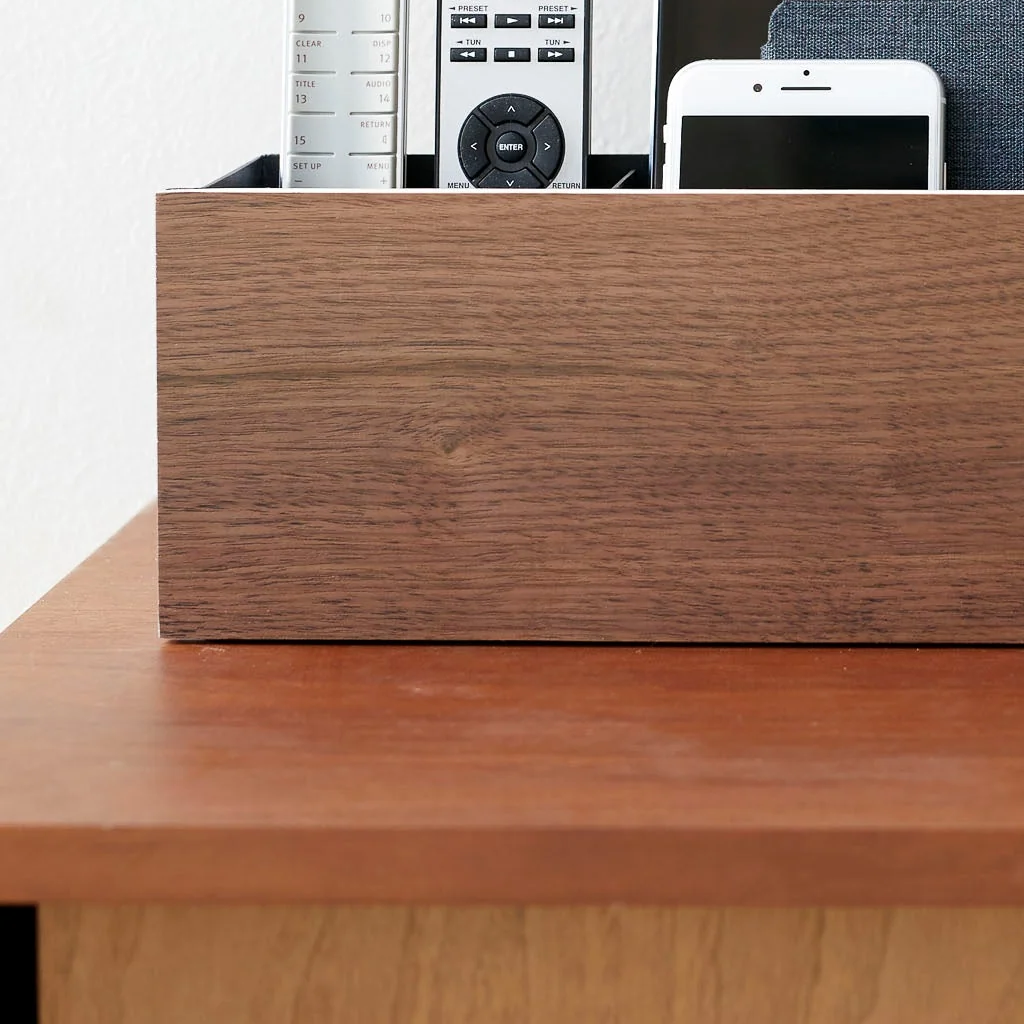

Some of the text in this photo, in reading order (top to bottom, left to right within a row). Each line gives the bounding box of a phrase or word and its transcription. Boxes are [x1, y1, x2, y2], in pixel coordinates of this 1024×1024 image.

[298, 14, 305, 23] 9
[381, 14, 391, 23] 10
[296, 40, 322, 48] CLEAR
[296, 54, 307, 63] 11
[379, 54, 391, 63] 12
[295, 94, 307, 104] 13
[294, 136, 306, 145] 15
[499, 143, 523, 151] ENTER
